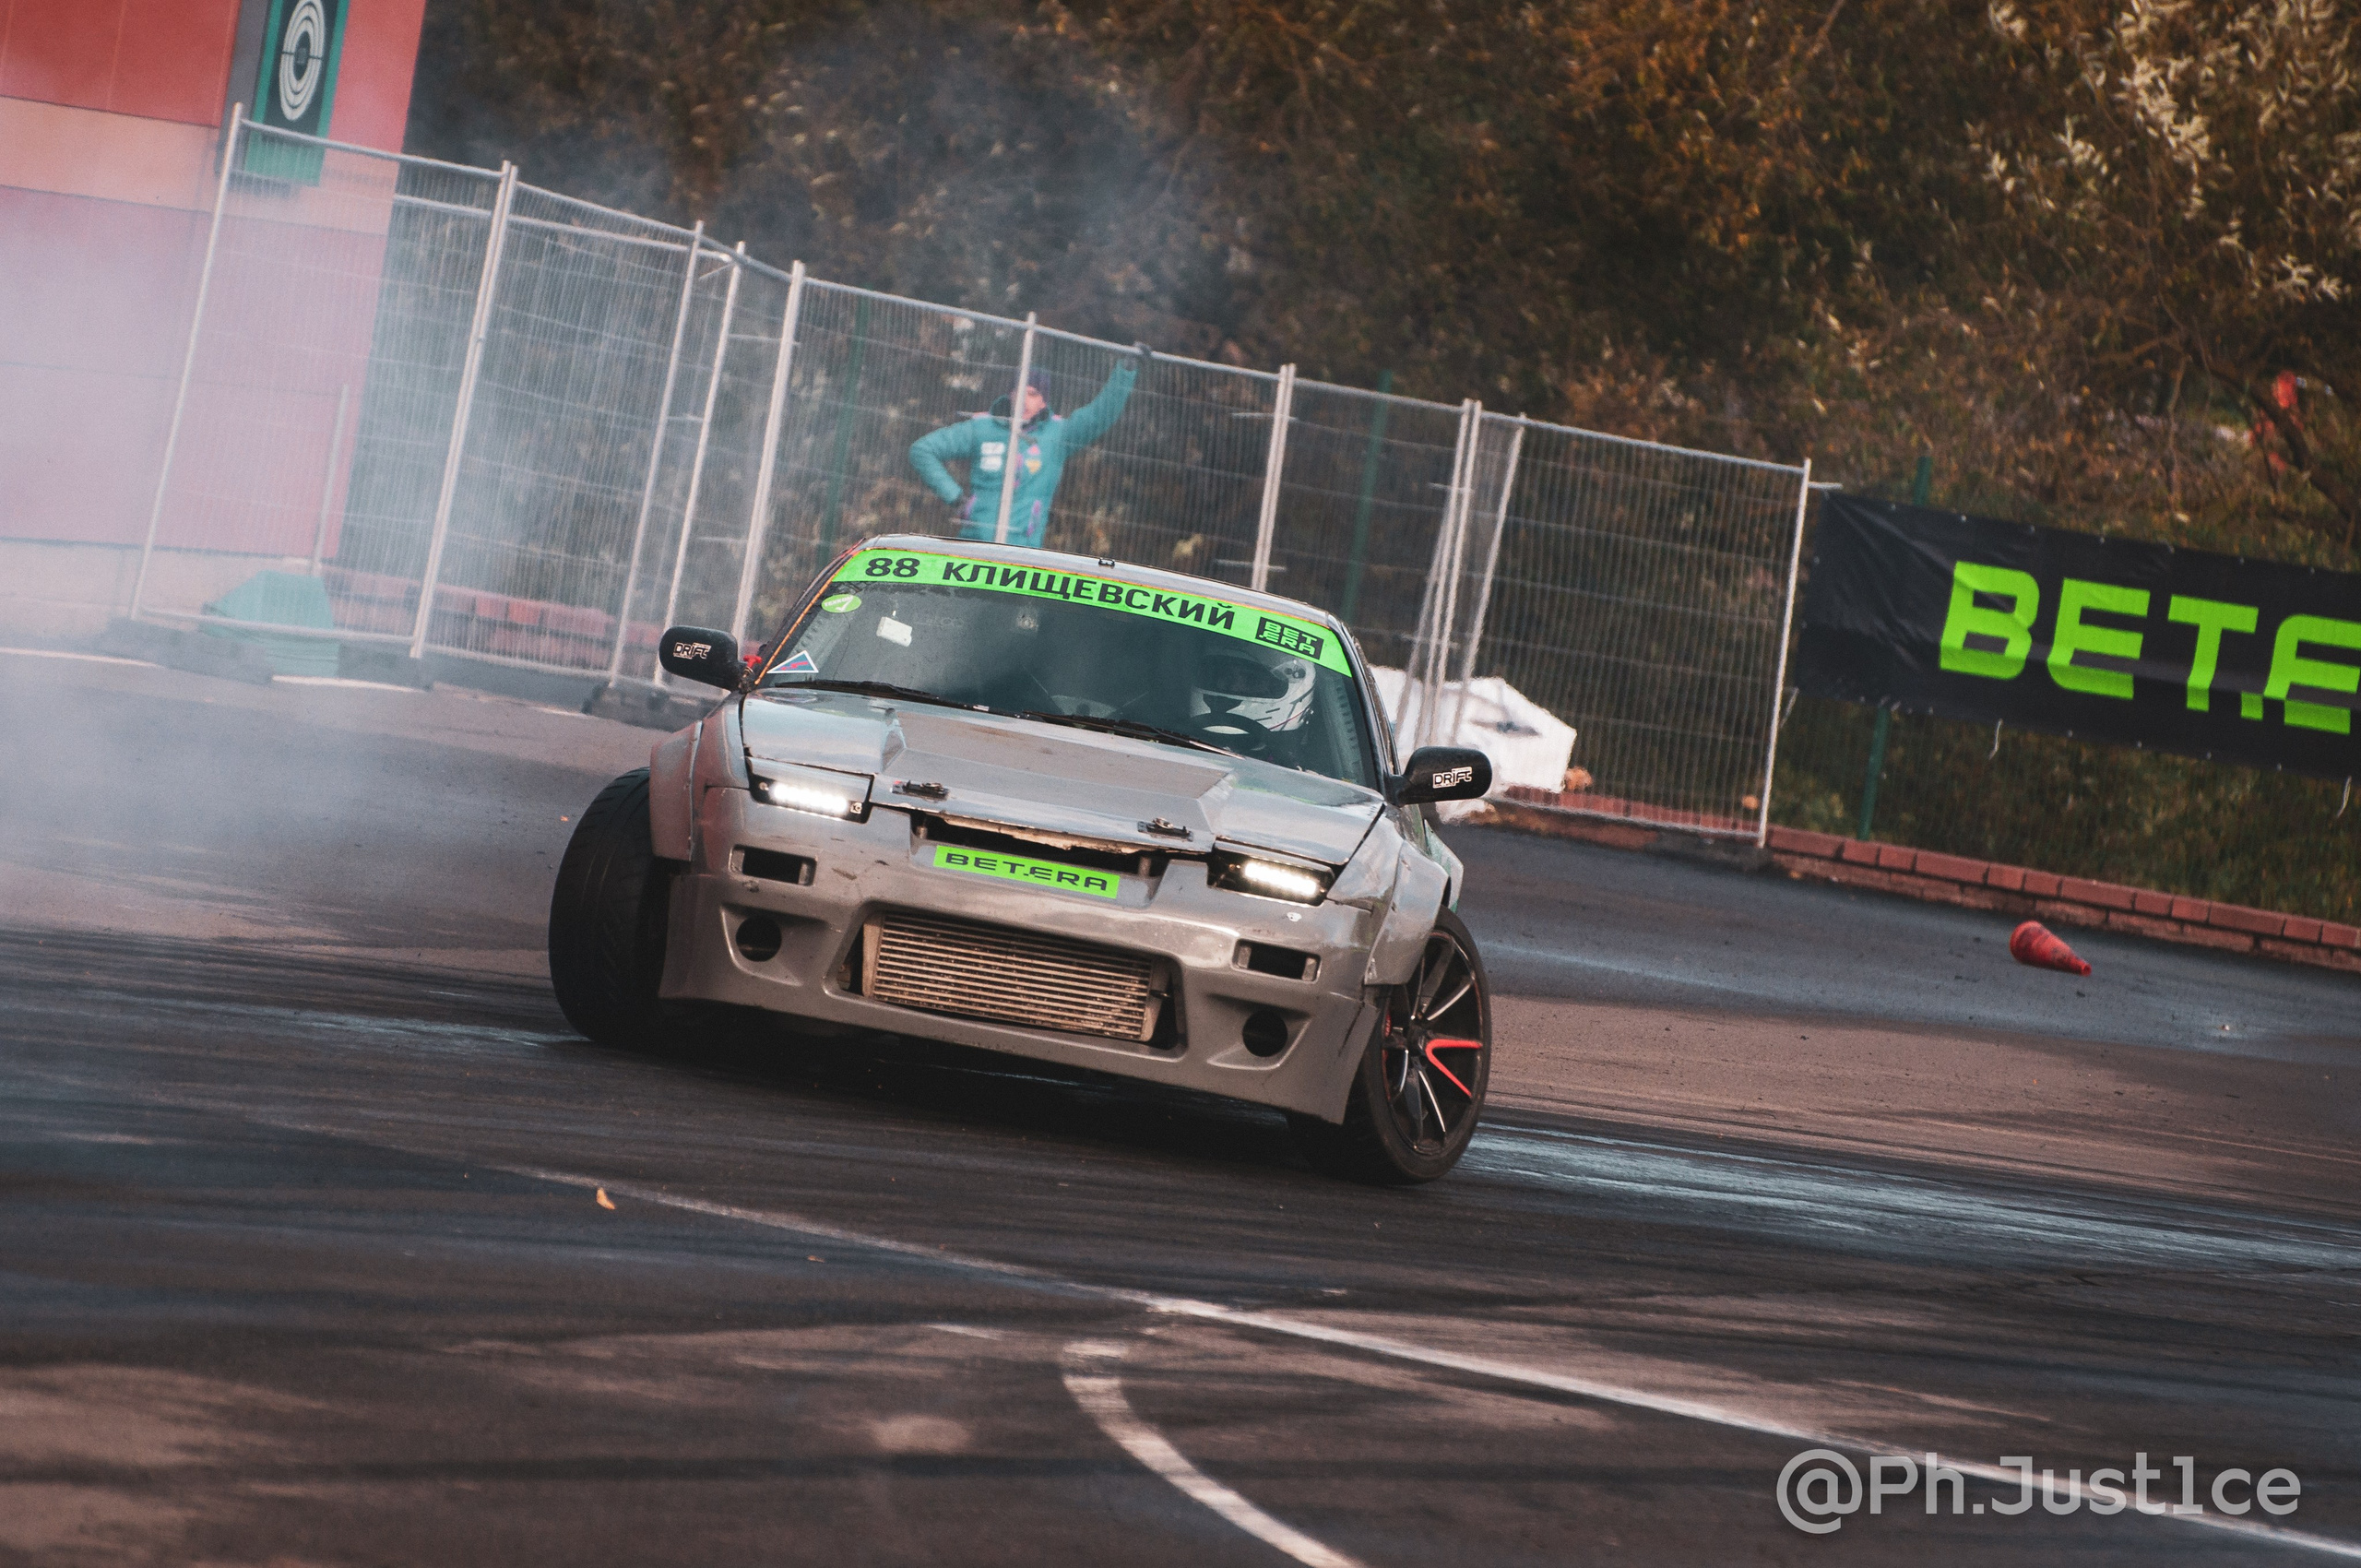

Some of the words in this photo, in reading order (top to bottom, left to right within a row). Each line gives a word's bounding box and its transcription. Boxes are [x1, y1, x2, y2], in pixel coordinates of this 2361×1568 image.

[864, 557, 919, 578] 88
[942, 562, 1236, 630] КЛИЩЕВСКИЙ
[1264, 621, 1318, 644] BET
